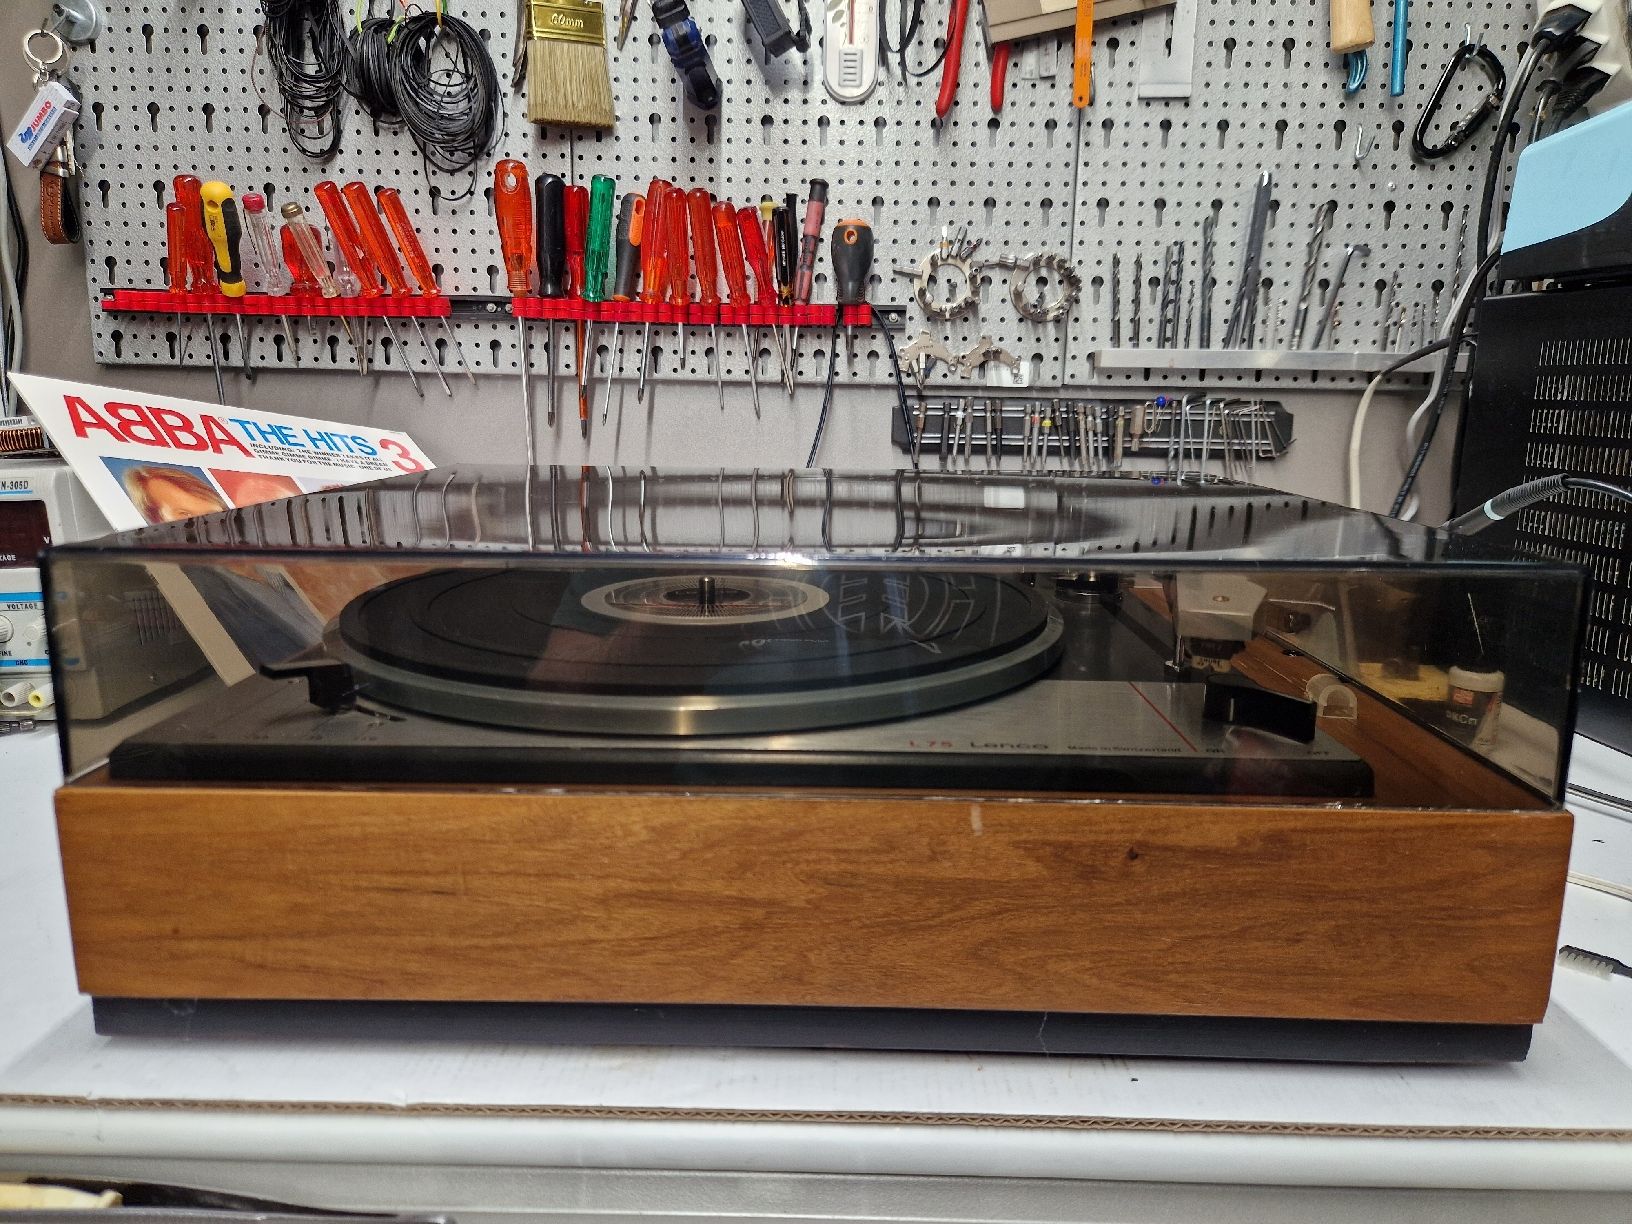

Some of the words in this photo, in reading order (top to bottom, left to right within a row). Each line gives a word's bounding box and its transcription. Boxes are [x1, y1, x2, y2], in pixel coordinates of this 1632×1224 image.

[551, 12, 584, 28] 60mm
[30, 100, 52, 132] JUMBO
[63, 394, 256, 459] ABBA
[229, 417, 306, 448] THE
[303, 428, 378, 456] HITS
[379, 438, 425, 475] 3
[43, 536, 50, 544] V
